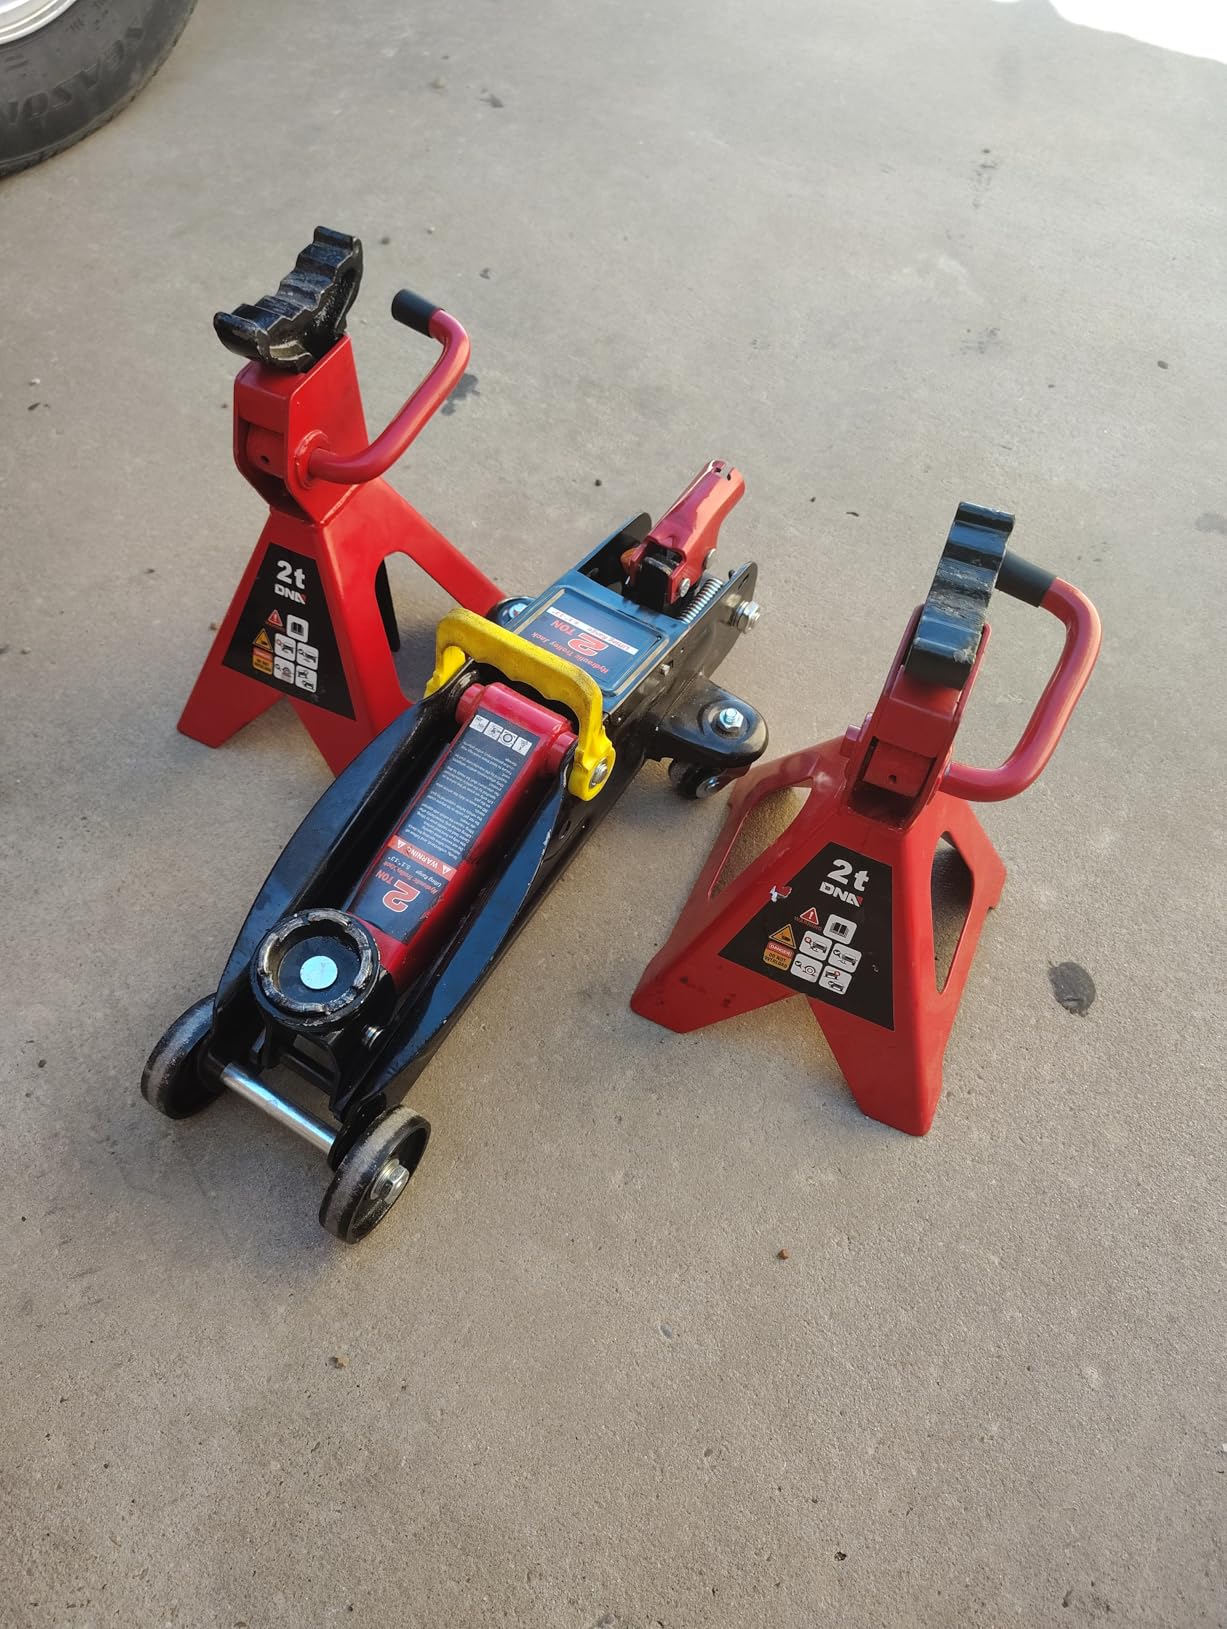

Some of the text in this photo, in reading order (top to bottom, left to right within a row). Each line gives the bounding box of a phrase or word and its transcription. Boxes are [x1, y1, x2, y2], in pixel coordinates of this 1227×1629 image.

[276, 560, 306, 590] 2t
[274, 583, 307, 605] DNA
[531, 631, 551, 643] Jack
[550, 619, 609, 656] 2 TON
[551, 641, 574, 657] Trolley
[826, 858, 870, 892] 2t
[375, 869, 420, 912] 2 TON
[819, 881, 864, 908] DNA
